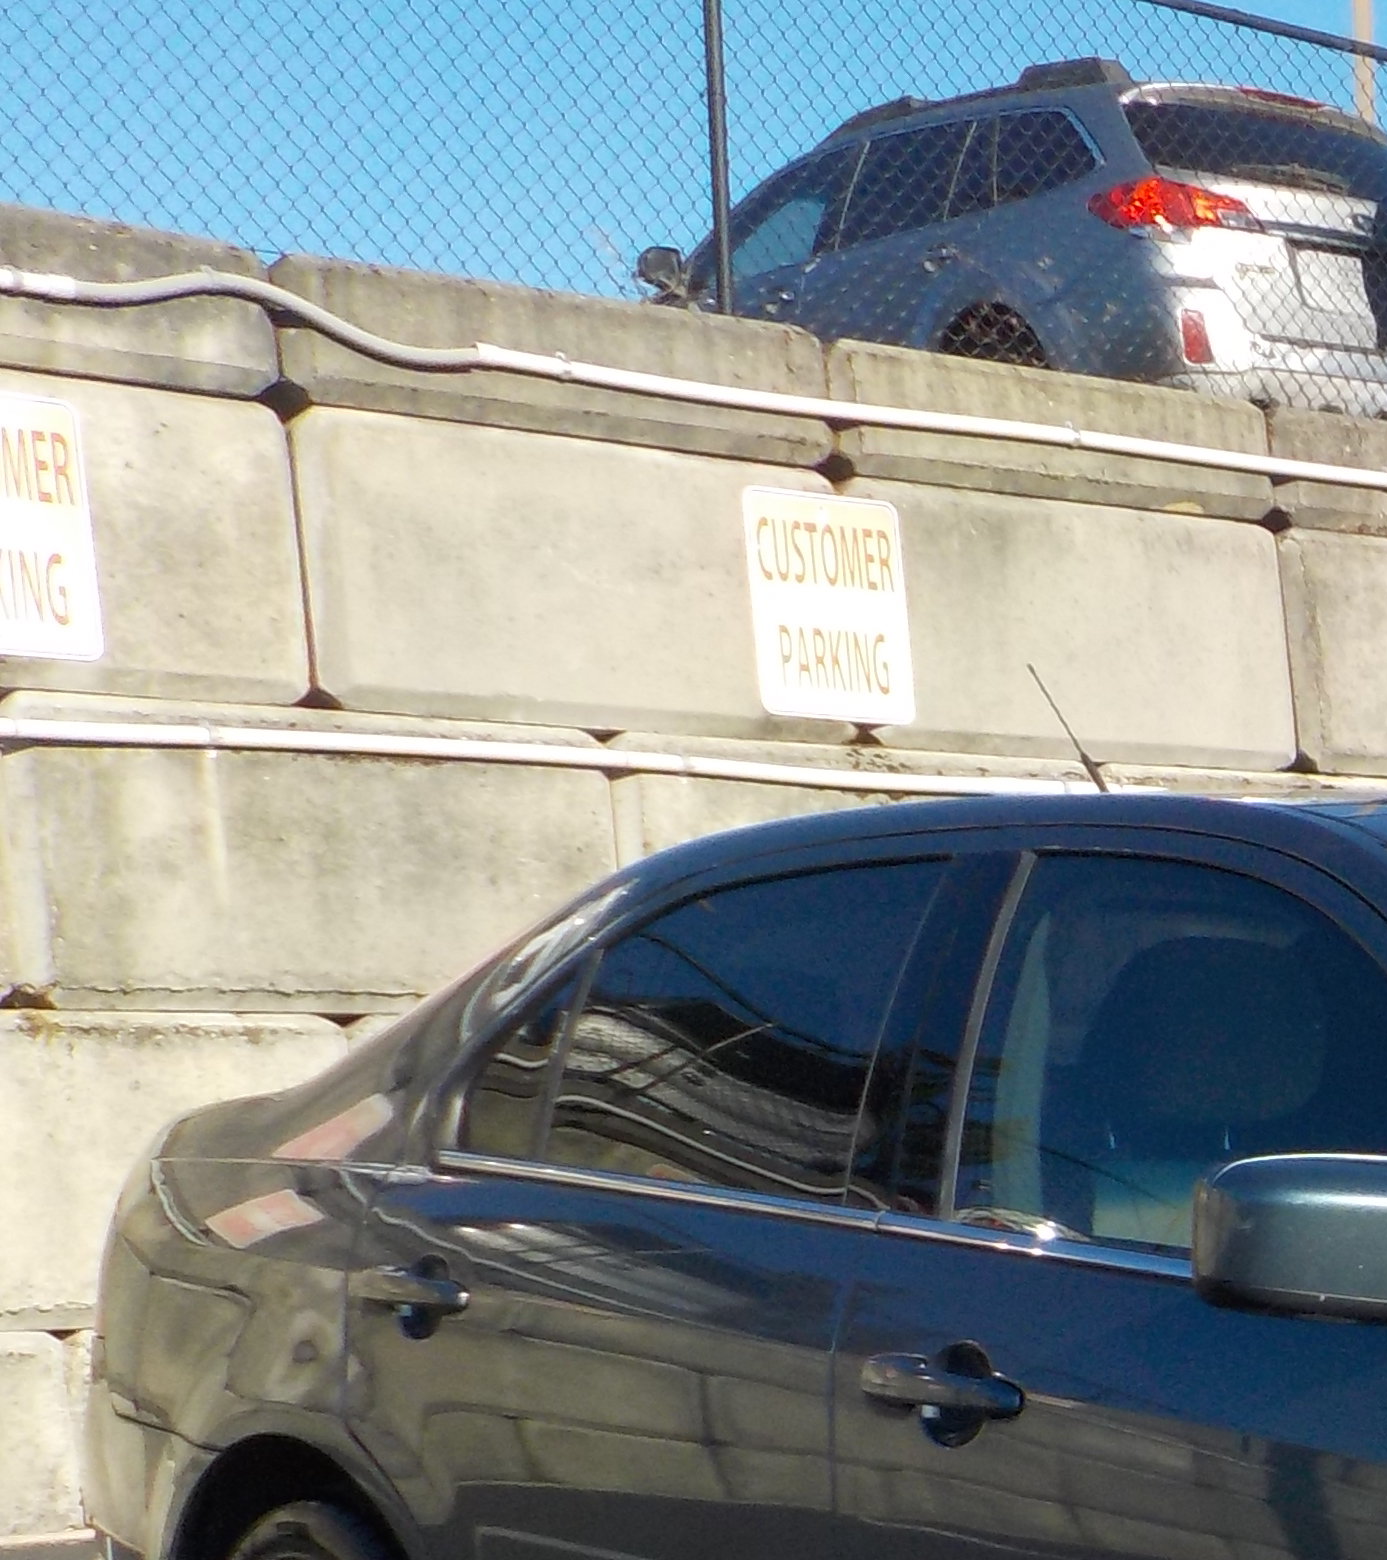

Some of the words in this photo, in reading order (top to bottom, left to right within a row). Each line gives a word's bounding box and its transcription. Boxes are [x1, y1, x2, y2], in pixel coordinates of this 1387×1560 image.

[0, 548, 70, 626] ING
[756, 516, 895, 593] CUSTOMER
[778, 624, 890, 695] PARKING
